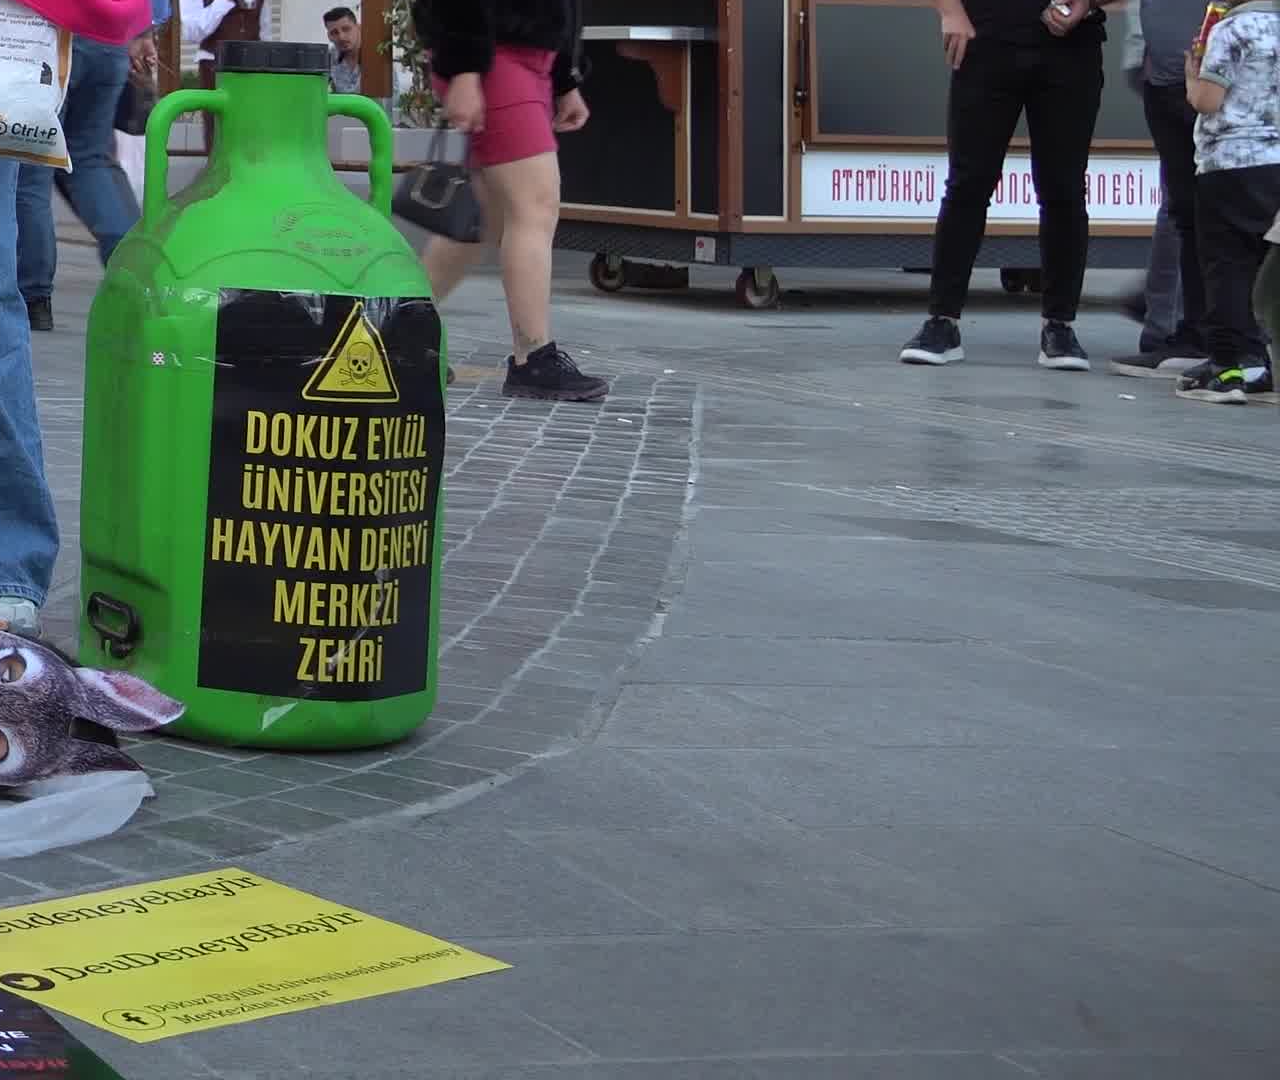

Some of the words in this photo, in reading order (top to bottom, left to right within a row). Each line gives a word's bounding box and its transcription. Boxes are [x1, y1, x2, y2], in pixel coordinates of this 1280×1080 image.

[10, 122, 58, 140] Ctrl+P
[832, 164, 936, 205] ATATÜRKÇÜ
[245, 410, 360, 461] DOKUZ
[367, 414, 428, 461] EYLÜL
[241, 463, 429, 517] ÜNİVERSİTESİ
[211, 518, 351, 572] HAYVAN
[359, 519, 429, 572] DENEYİ
[273, 578, 401, 627] MERKEZİ
[296, 634, 385, 683] ZEHRİ
[144, 995, 212, 1014] Dokuz
[401, 946, 463, 966] Deney
